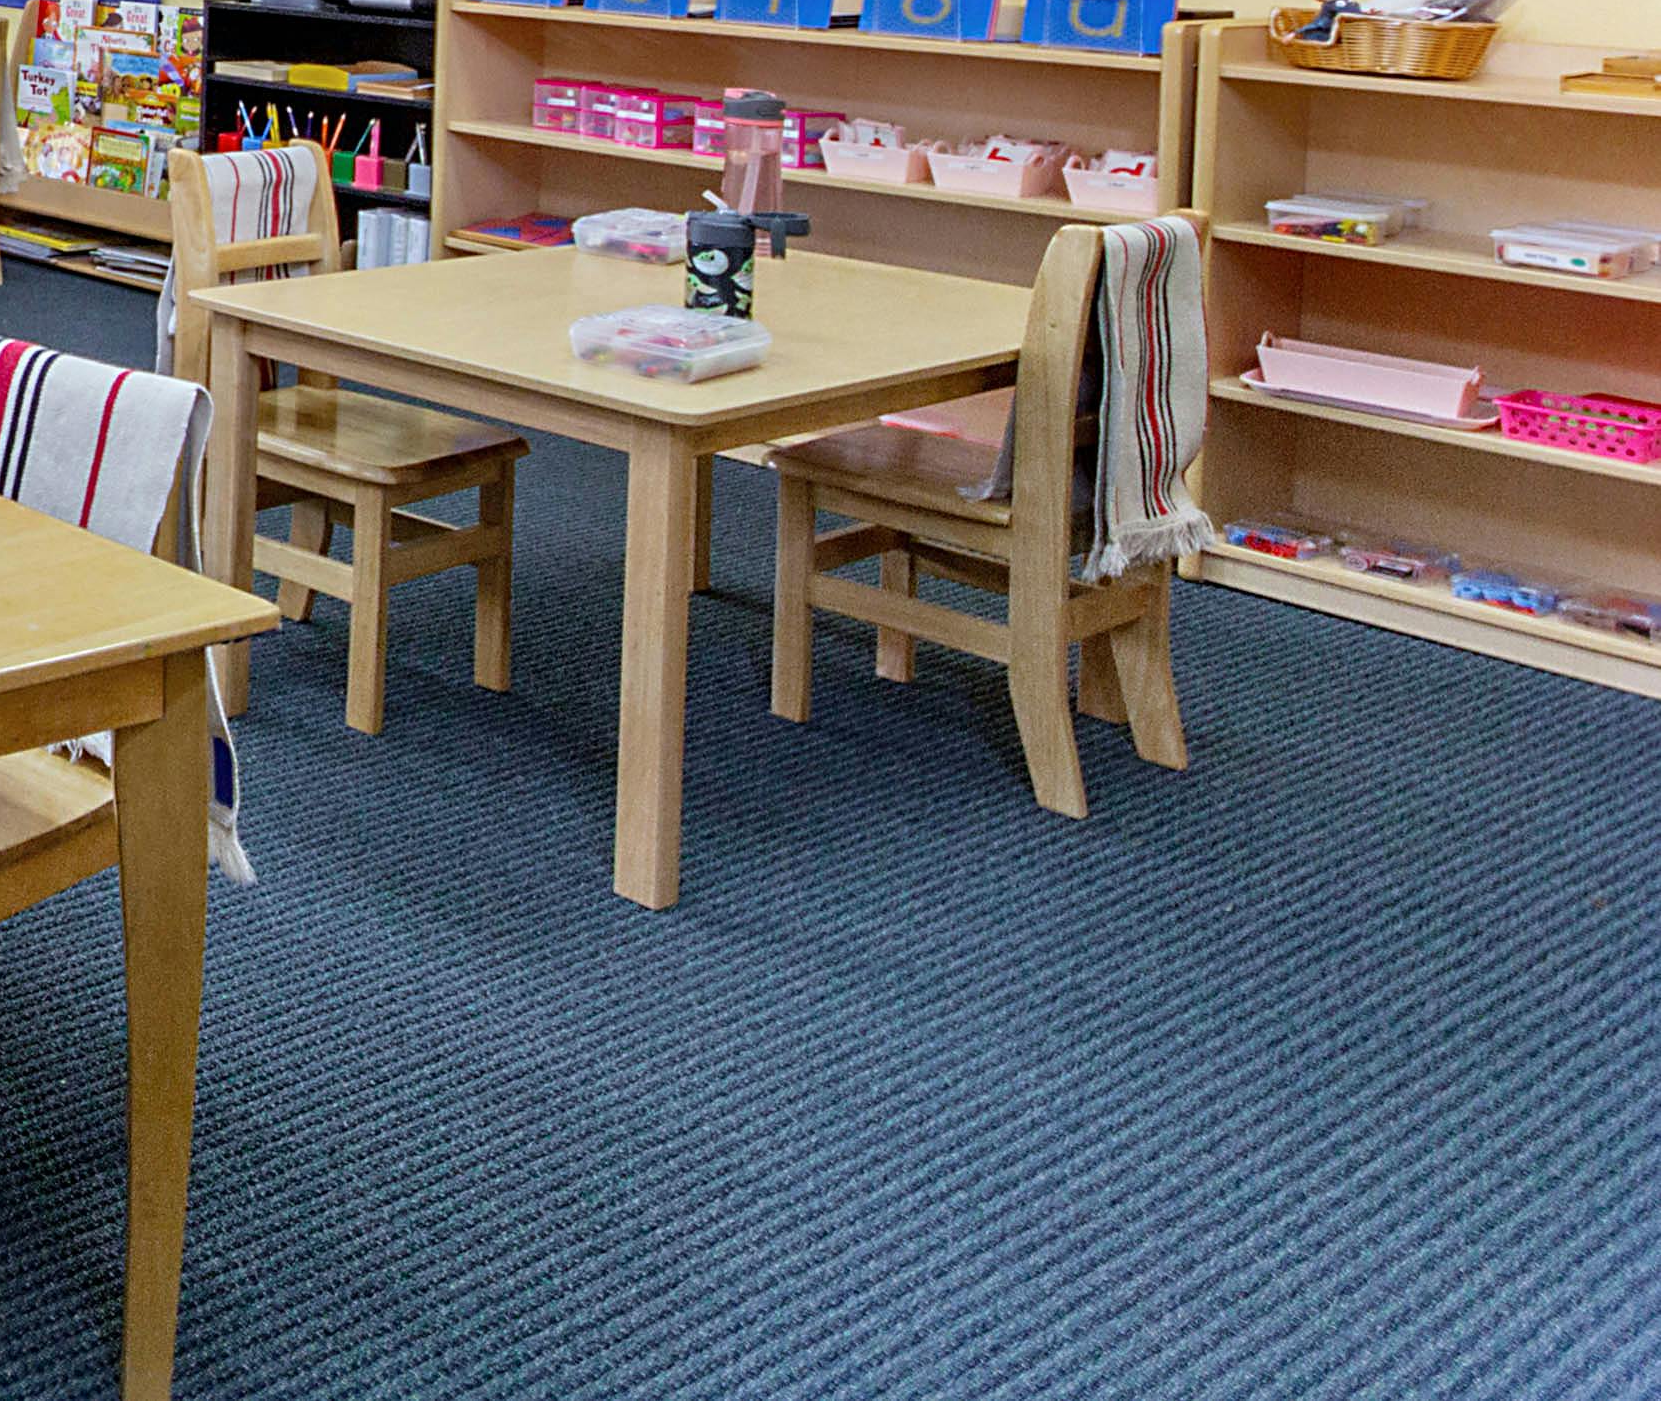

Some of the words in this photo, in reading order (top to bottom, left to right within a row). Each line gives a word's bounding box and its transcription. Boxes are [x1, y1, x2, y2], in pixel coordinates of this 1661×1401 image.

[127, 11, 148, 23] Great
[21, 70, 56, 86] Turkey
[30, 84, 48, 97] Tot
